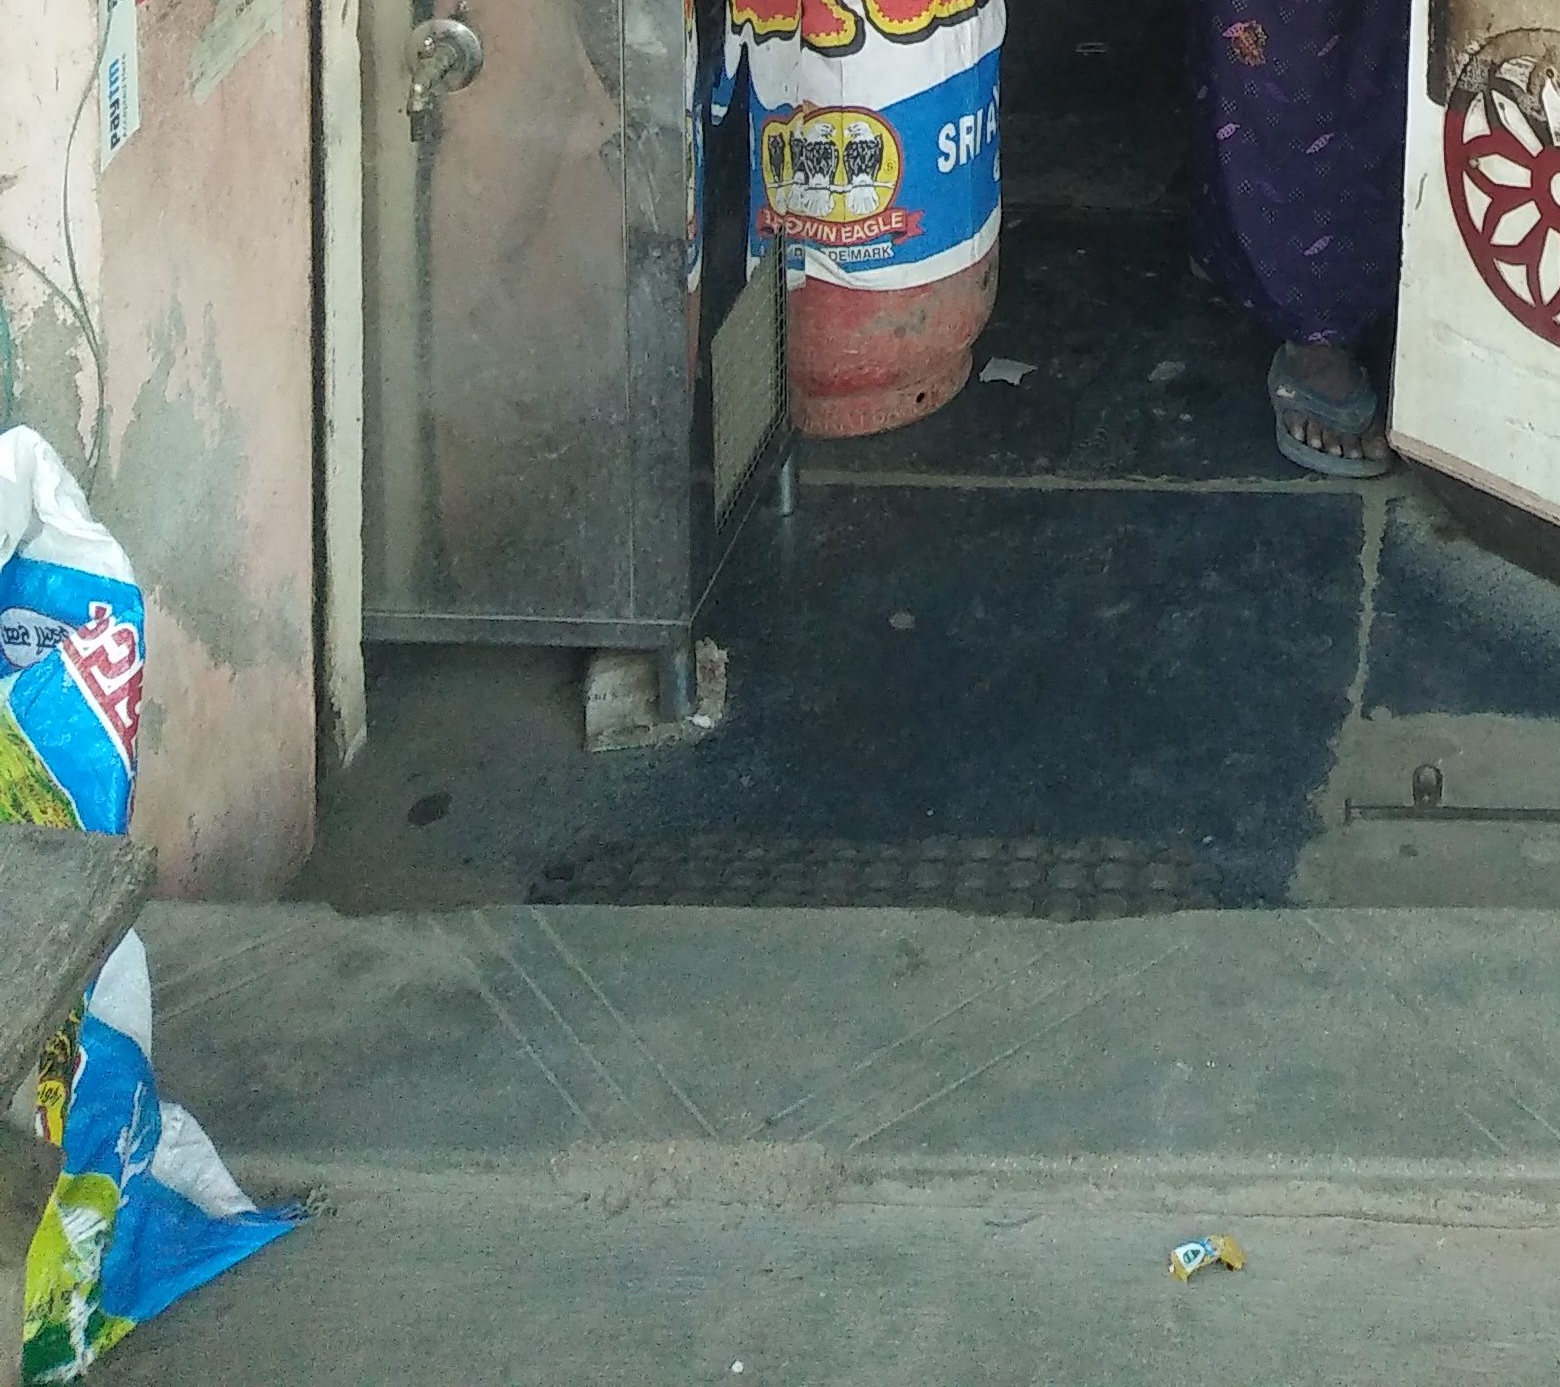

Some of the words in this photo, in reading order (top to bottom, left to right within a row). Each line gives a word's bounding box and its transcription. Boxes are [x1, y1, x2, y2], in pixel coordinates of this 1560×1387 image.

[937, 111, 984, 174] SRI
[841, 211, 904, 242] EAGLE
[851, 245, 892, 260] MARK
